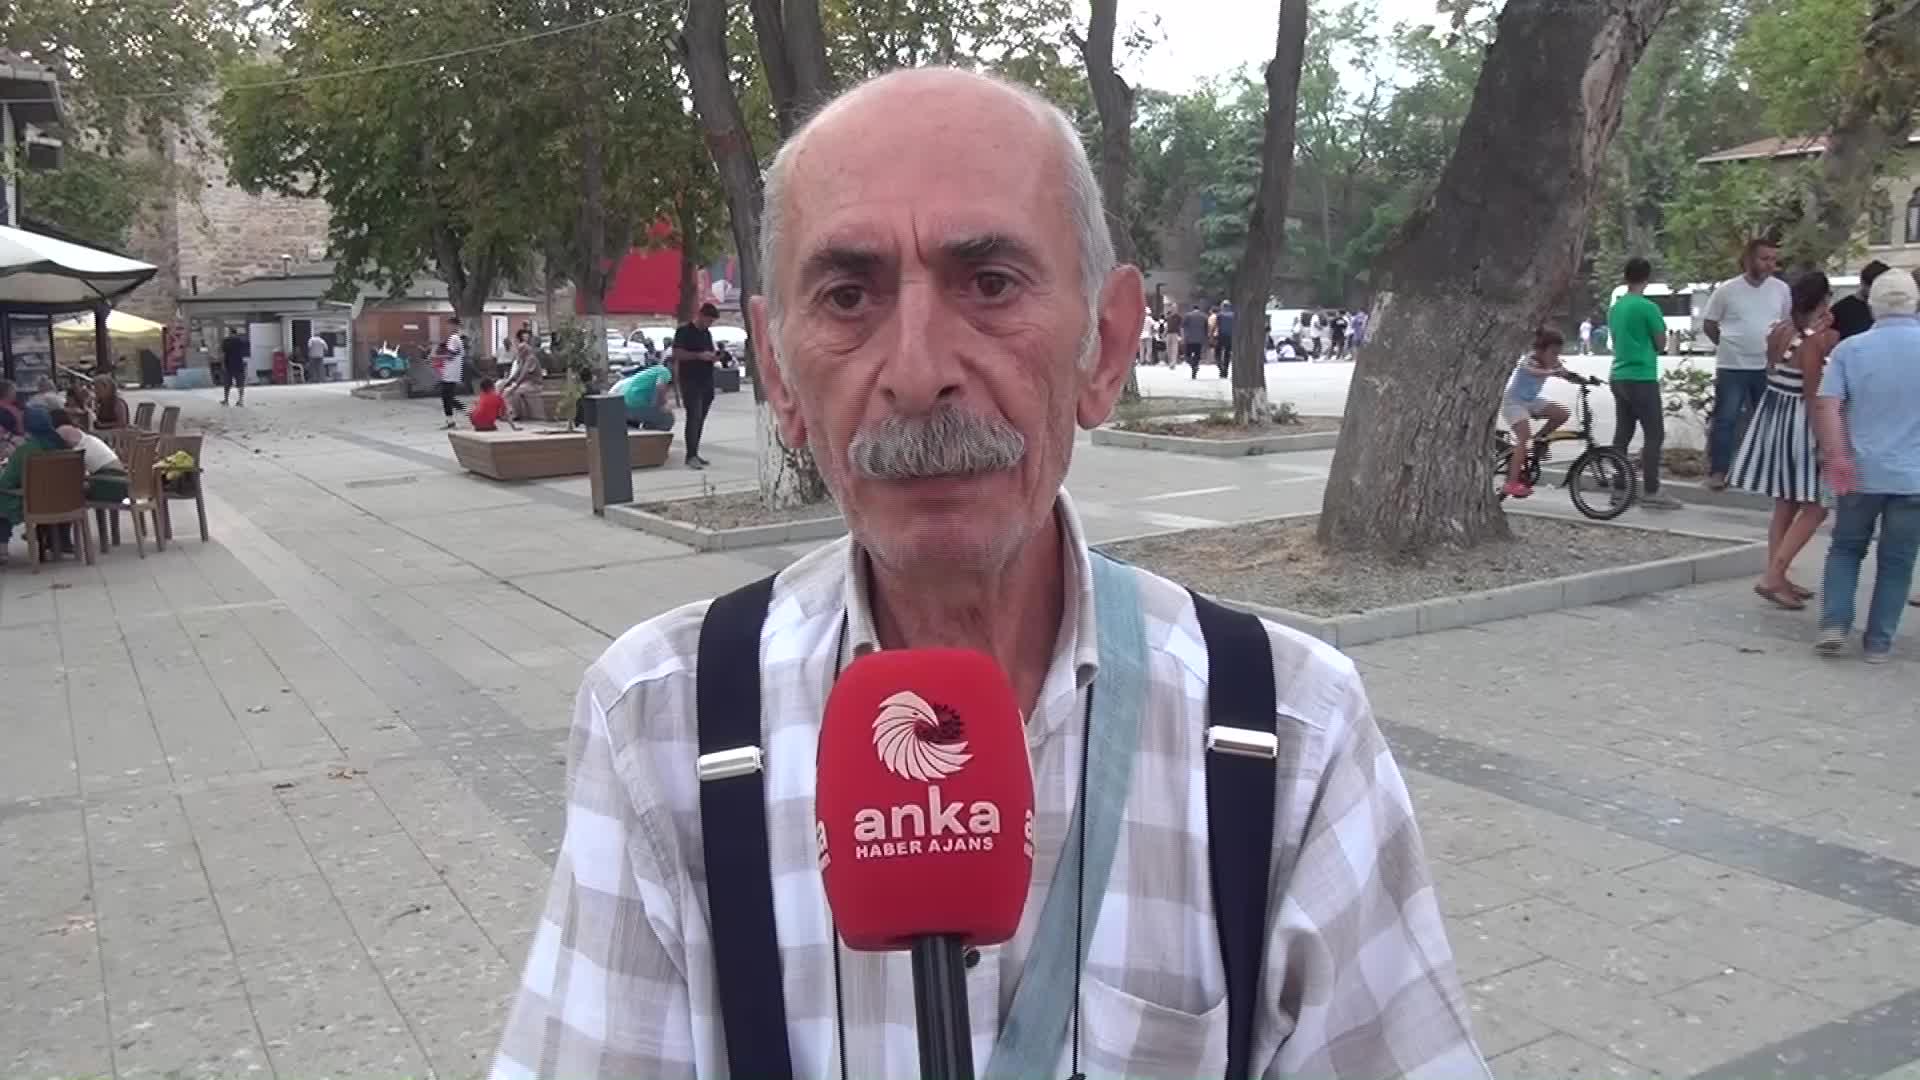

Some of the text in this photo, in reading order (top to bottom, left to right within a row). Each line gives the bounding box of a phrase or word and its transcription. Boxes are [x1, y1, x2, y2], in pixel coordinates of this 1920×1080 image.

[854, 785, 1001, 841] anka
[855, 836, 993, 860] HABER AJANS
